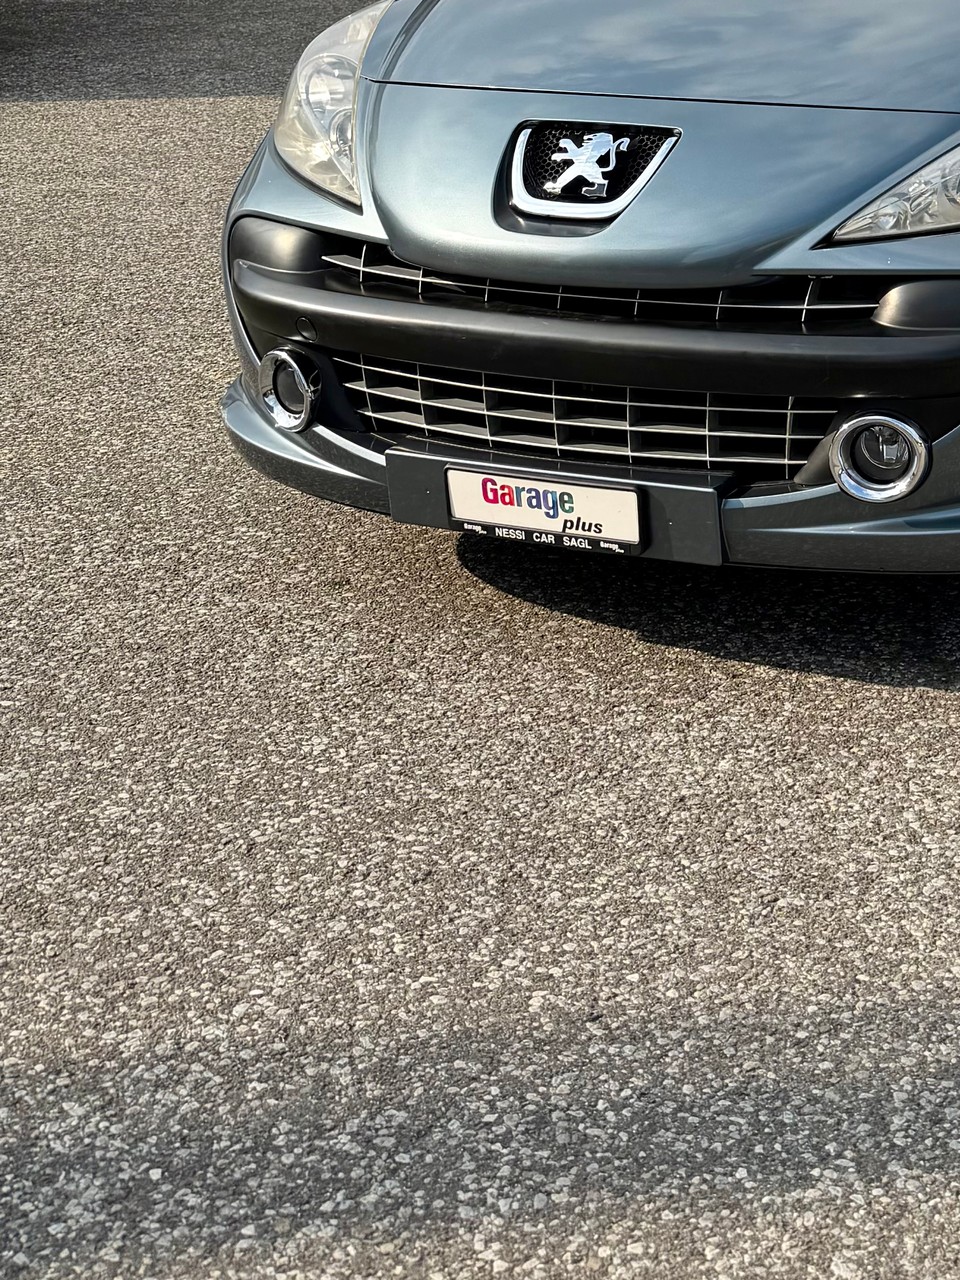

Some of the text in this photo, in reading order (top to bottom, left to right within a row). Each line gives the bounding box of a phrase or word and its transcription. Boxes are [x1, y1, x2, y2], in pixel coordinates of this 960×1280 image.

[481, 477, 575, 519] Garage
[561, 516, 604, 534] plus
[495, 527, 526, 540] NESSI
[532, 532, 556, 544] CAR
[563, 536, 593, 549] SAGL
